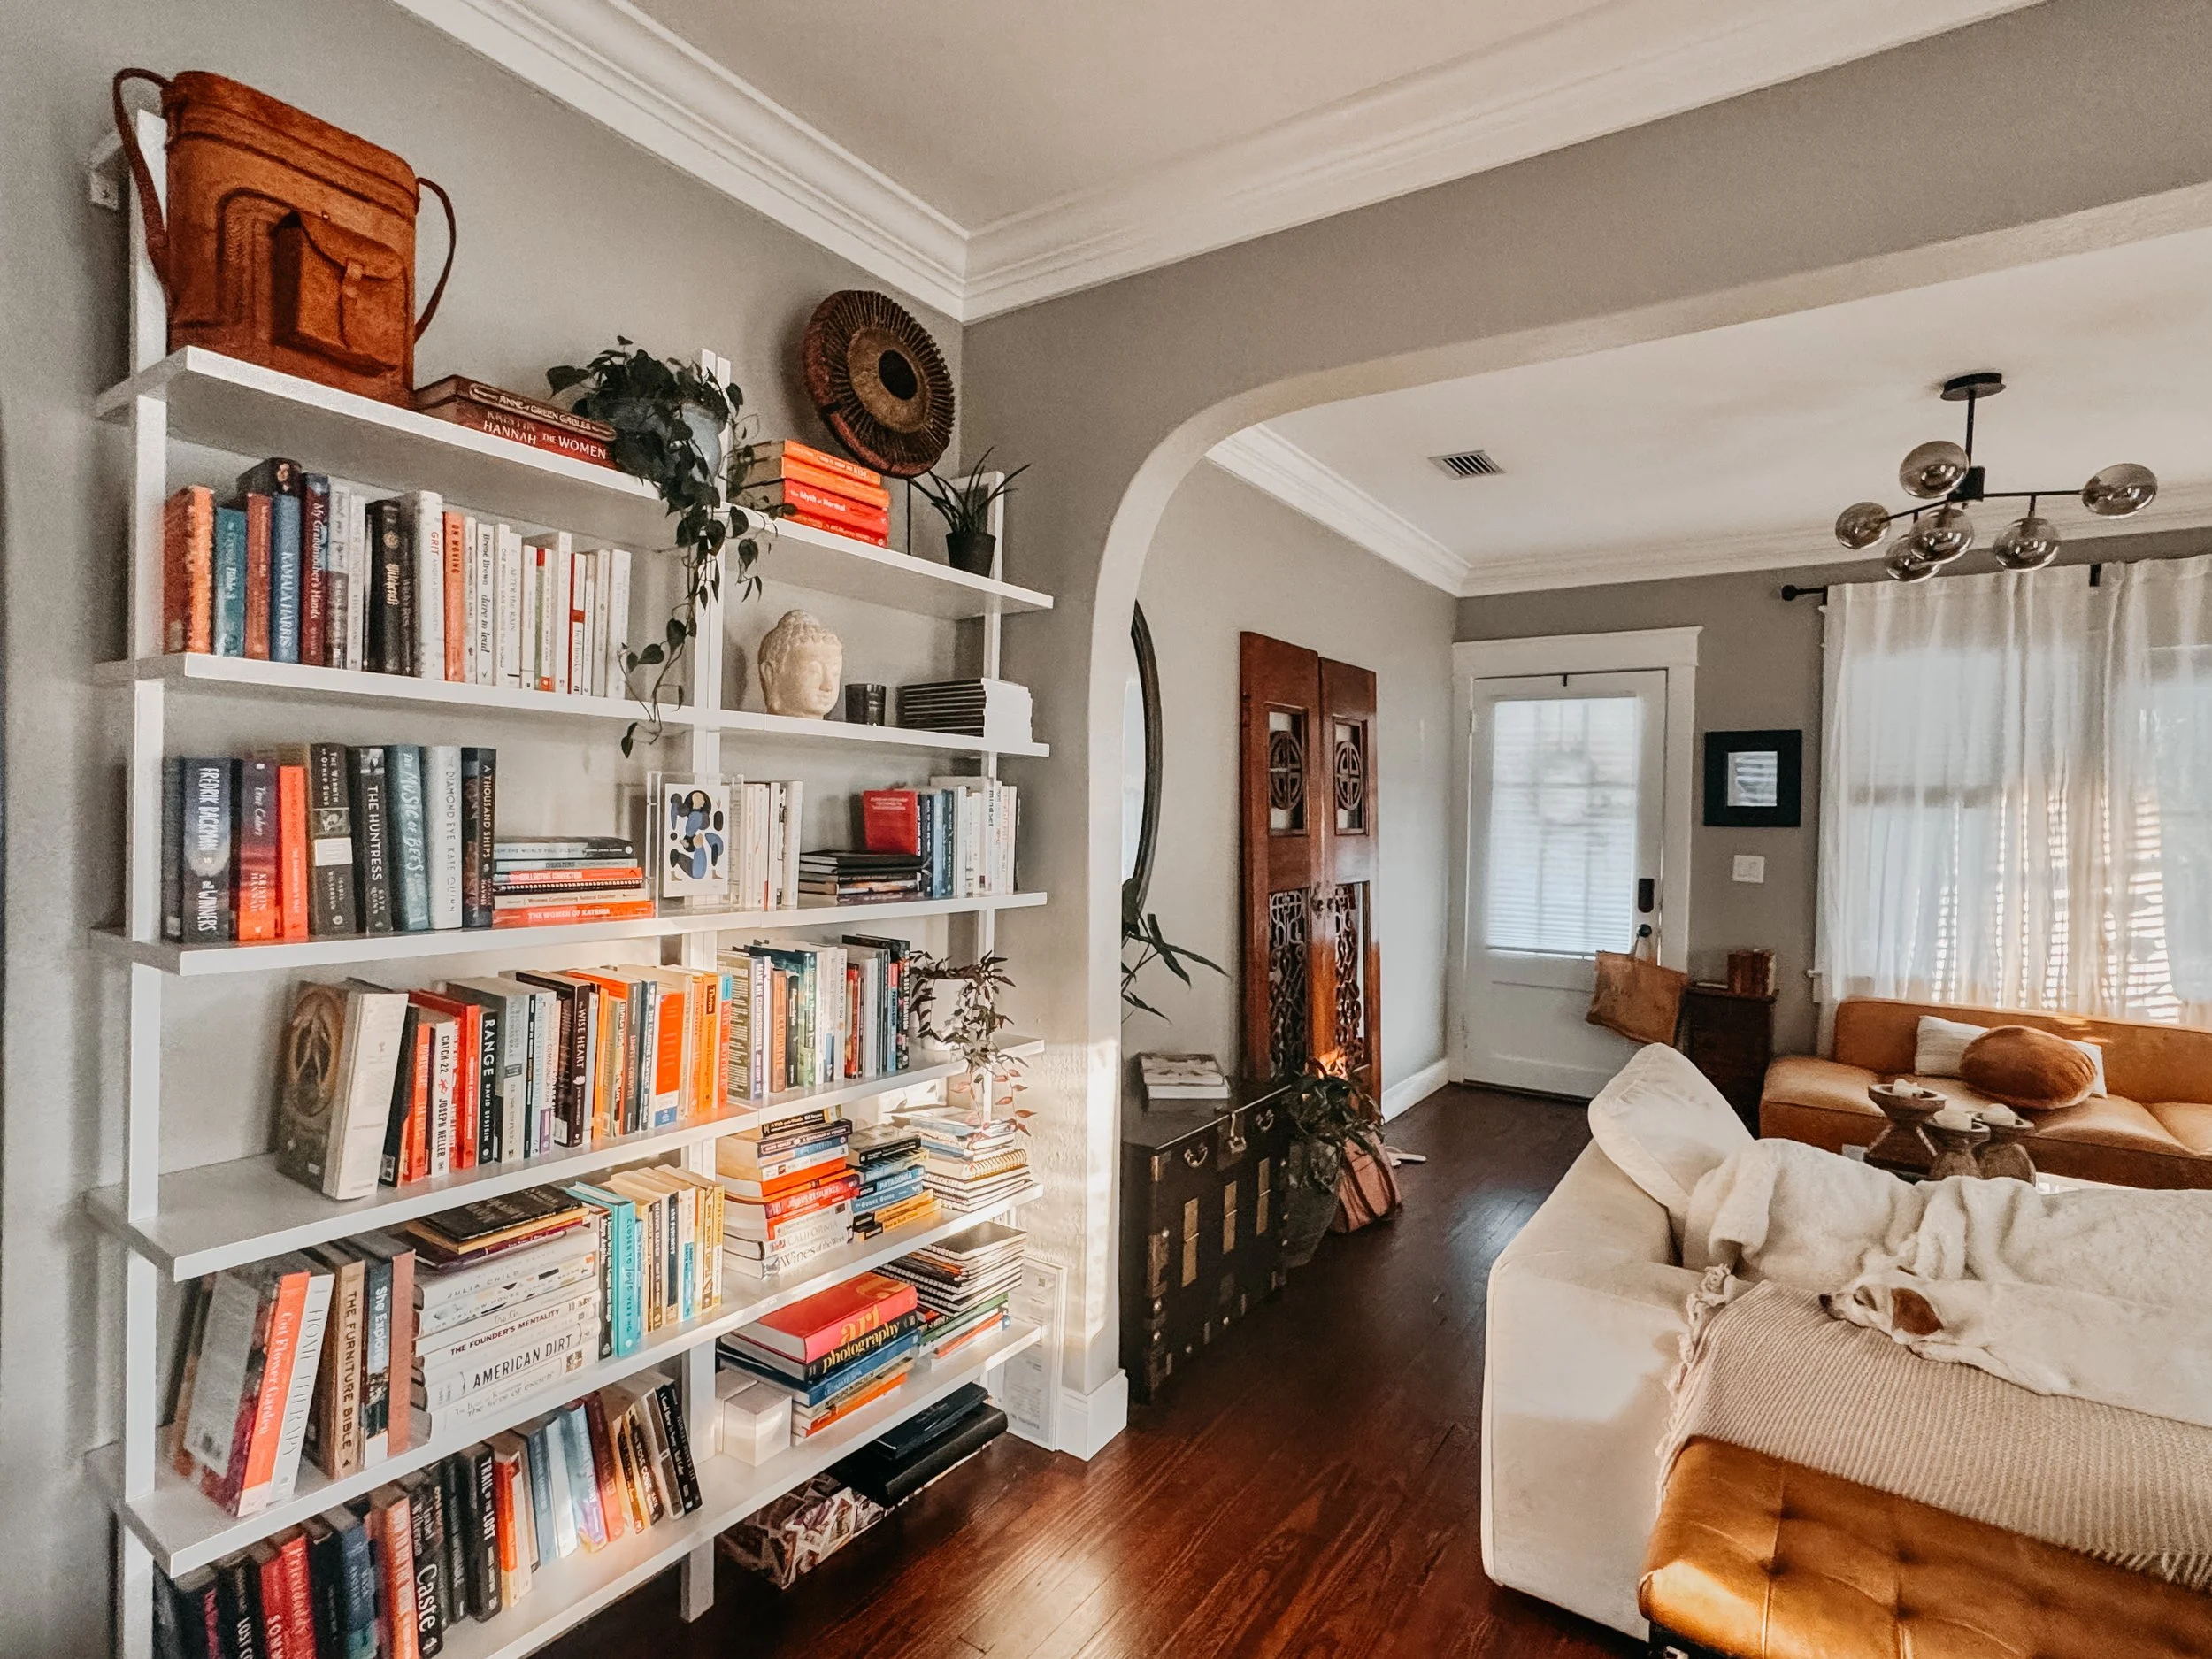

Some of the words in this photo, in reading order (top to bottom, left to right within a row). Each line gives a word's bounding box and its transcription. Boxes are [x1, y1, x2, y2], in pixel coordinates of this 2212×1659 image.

[487, 411, 535, 433] KRISTIN
[499, 396, 524, 409] ANNE
[531, 405, 558, 420] GREEN
[484, 421, 536, 445] HANNAH
[542, 433, 557, 444] THE
[559, 437, 606, 460] WOMEN
[311, 503, 324, 517] My
[800, 491, 817, 504] Myth
[823, 499, 846, 511] Normal
[431, 531, 440, 556] GRIT
[451, 524, 460, 534] ON
[311, 520, 324, 587] Grandmother's
[451, 540, 460, 574] MOVING
[280, 552, 295, 600] KAMALA
[310, 590, 320, 619] Hands
[480, 595, 490, 617] dare
[280, 603, 294, 647] HARRIS
[481, 620, 490, 629] to
[480, 632, 490, 653] lead
[197, 767, 219, 804] FREDRIK
[254, 786, 266, 804] True
[367, 786, 379, 810] THE
[401, 772, 418, 818] MUSIC
[445, 772, 455, 818] DIAMOND
[483, 776, 492, 829] THOUSAND
[197, 807, 220, 851] BACKMAN
[254, 808, 267, 837] Colors
[407, 821, 417, 833] OF
[445, 822, 456, 841] EYE
[369, 814, 382, 880] HUNTRESS
[403, 836, 423, 871] BEES
[445, 847, 456, 871] KATE
[482, 831, 492, 858] SHIPS
[258, 873, 267, 910] KRISTIN
[445, 877, 455, 912] QUINN
[197, 890, 218, 932] WINNERS
[528, 912, 542, 921] THE
[543, 911, 571, 920] WOMEN
[755, 963, 764, 984] MAKE
[707, 987, 716, 1013] Thrive
[755, 986, 763, 995] ME
[577, 1009, 586, 1033] WISE
[483, 1018, 496, 1077] RANGE
[576, 1036, 585, 1068] HEART
[437, 1098, 449, 1126] JOSEPH
[437, 1130, 448, 1158] HELLER
[879, 1171, 913, 1190] PATAGONIA
[787, 1221, 838, 1246] CALIFORNIA
[626, 1252, 633, 1264] TO
[780, 1246, 816, 1267] Wines
[374, 1287, 388, 1311] She
[446, 1283, 480, 1300] JULIA
[487, 1270, 520, 1285] CHILD
[346, 1291, 357, 1317] THE
[276, 1312, 295, 1337] Cut
[299, 1309, 325, 1361] HOME
[449, 1345, 467, 1356] THE
[470, 1325, 517, 1348] FOUNDER'S
[518, 1309, 560, 1330] MENTALITY
[840, 1305, 882, 1346] art
[267, 1339, 290, 1384] Flower
[342, 1323, 357, 1402] FURNITURE
[472, 1347, 541, 1389] AMERICAN
[545, 1333, 572, 1357] DIRT
[822, 1322, 901, 1374] photography
[257, 1386, 279, 1435] Garden
[282, 1375, 311, 1456] THERAPY
[342, 1408, 354, 1449] BIBLE
[480, 1456, 494, 1493] TRAIL
[641, 1467, 652, 1492] CODE
[412, 1502, 424, 1556] Wilkerson
[422, 1505, 434, 1540] Isabel
[483, 1511, 496, 1540] LOST
[288, 1548, 309, 1634] Priestdaddy
[417, 1563, 439, 1632] Caste
[236, 1616, 252, 1648] LOST
